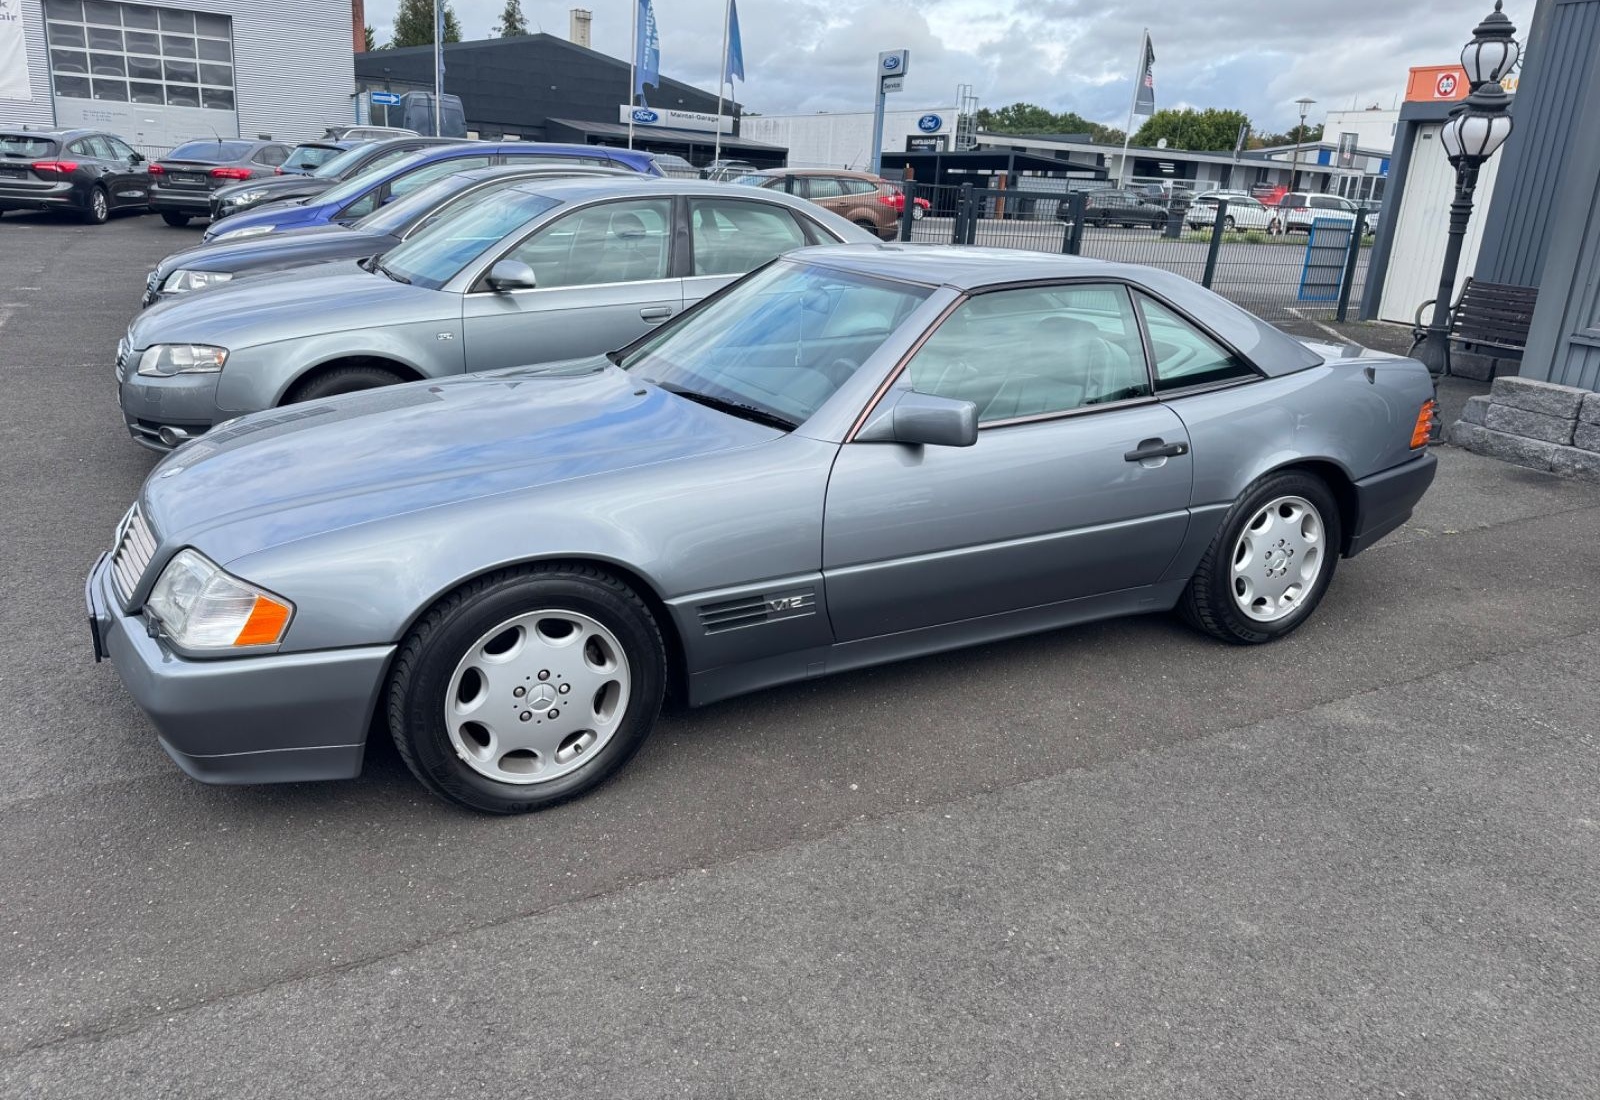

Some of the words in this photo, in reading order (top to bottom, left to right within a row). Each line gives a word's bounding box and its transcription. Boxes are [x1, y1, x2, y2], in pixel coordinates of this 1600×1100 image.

[633, 111, 655, 121] Ford
[921, 116, 937, 128] Ford
[770, 596, 802, 610] V12
